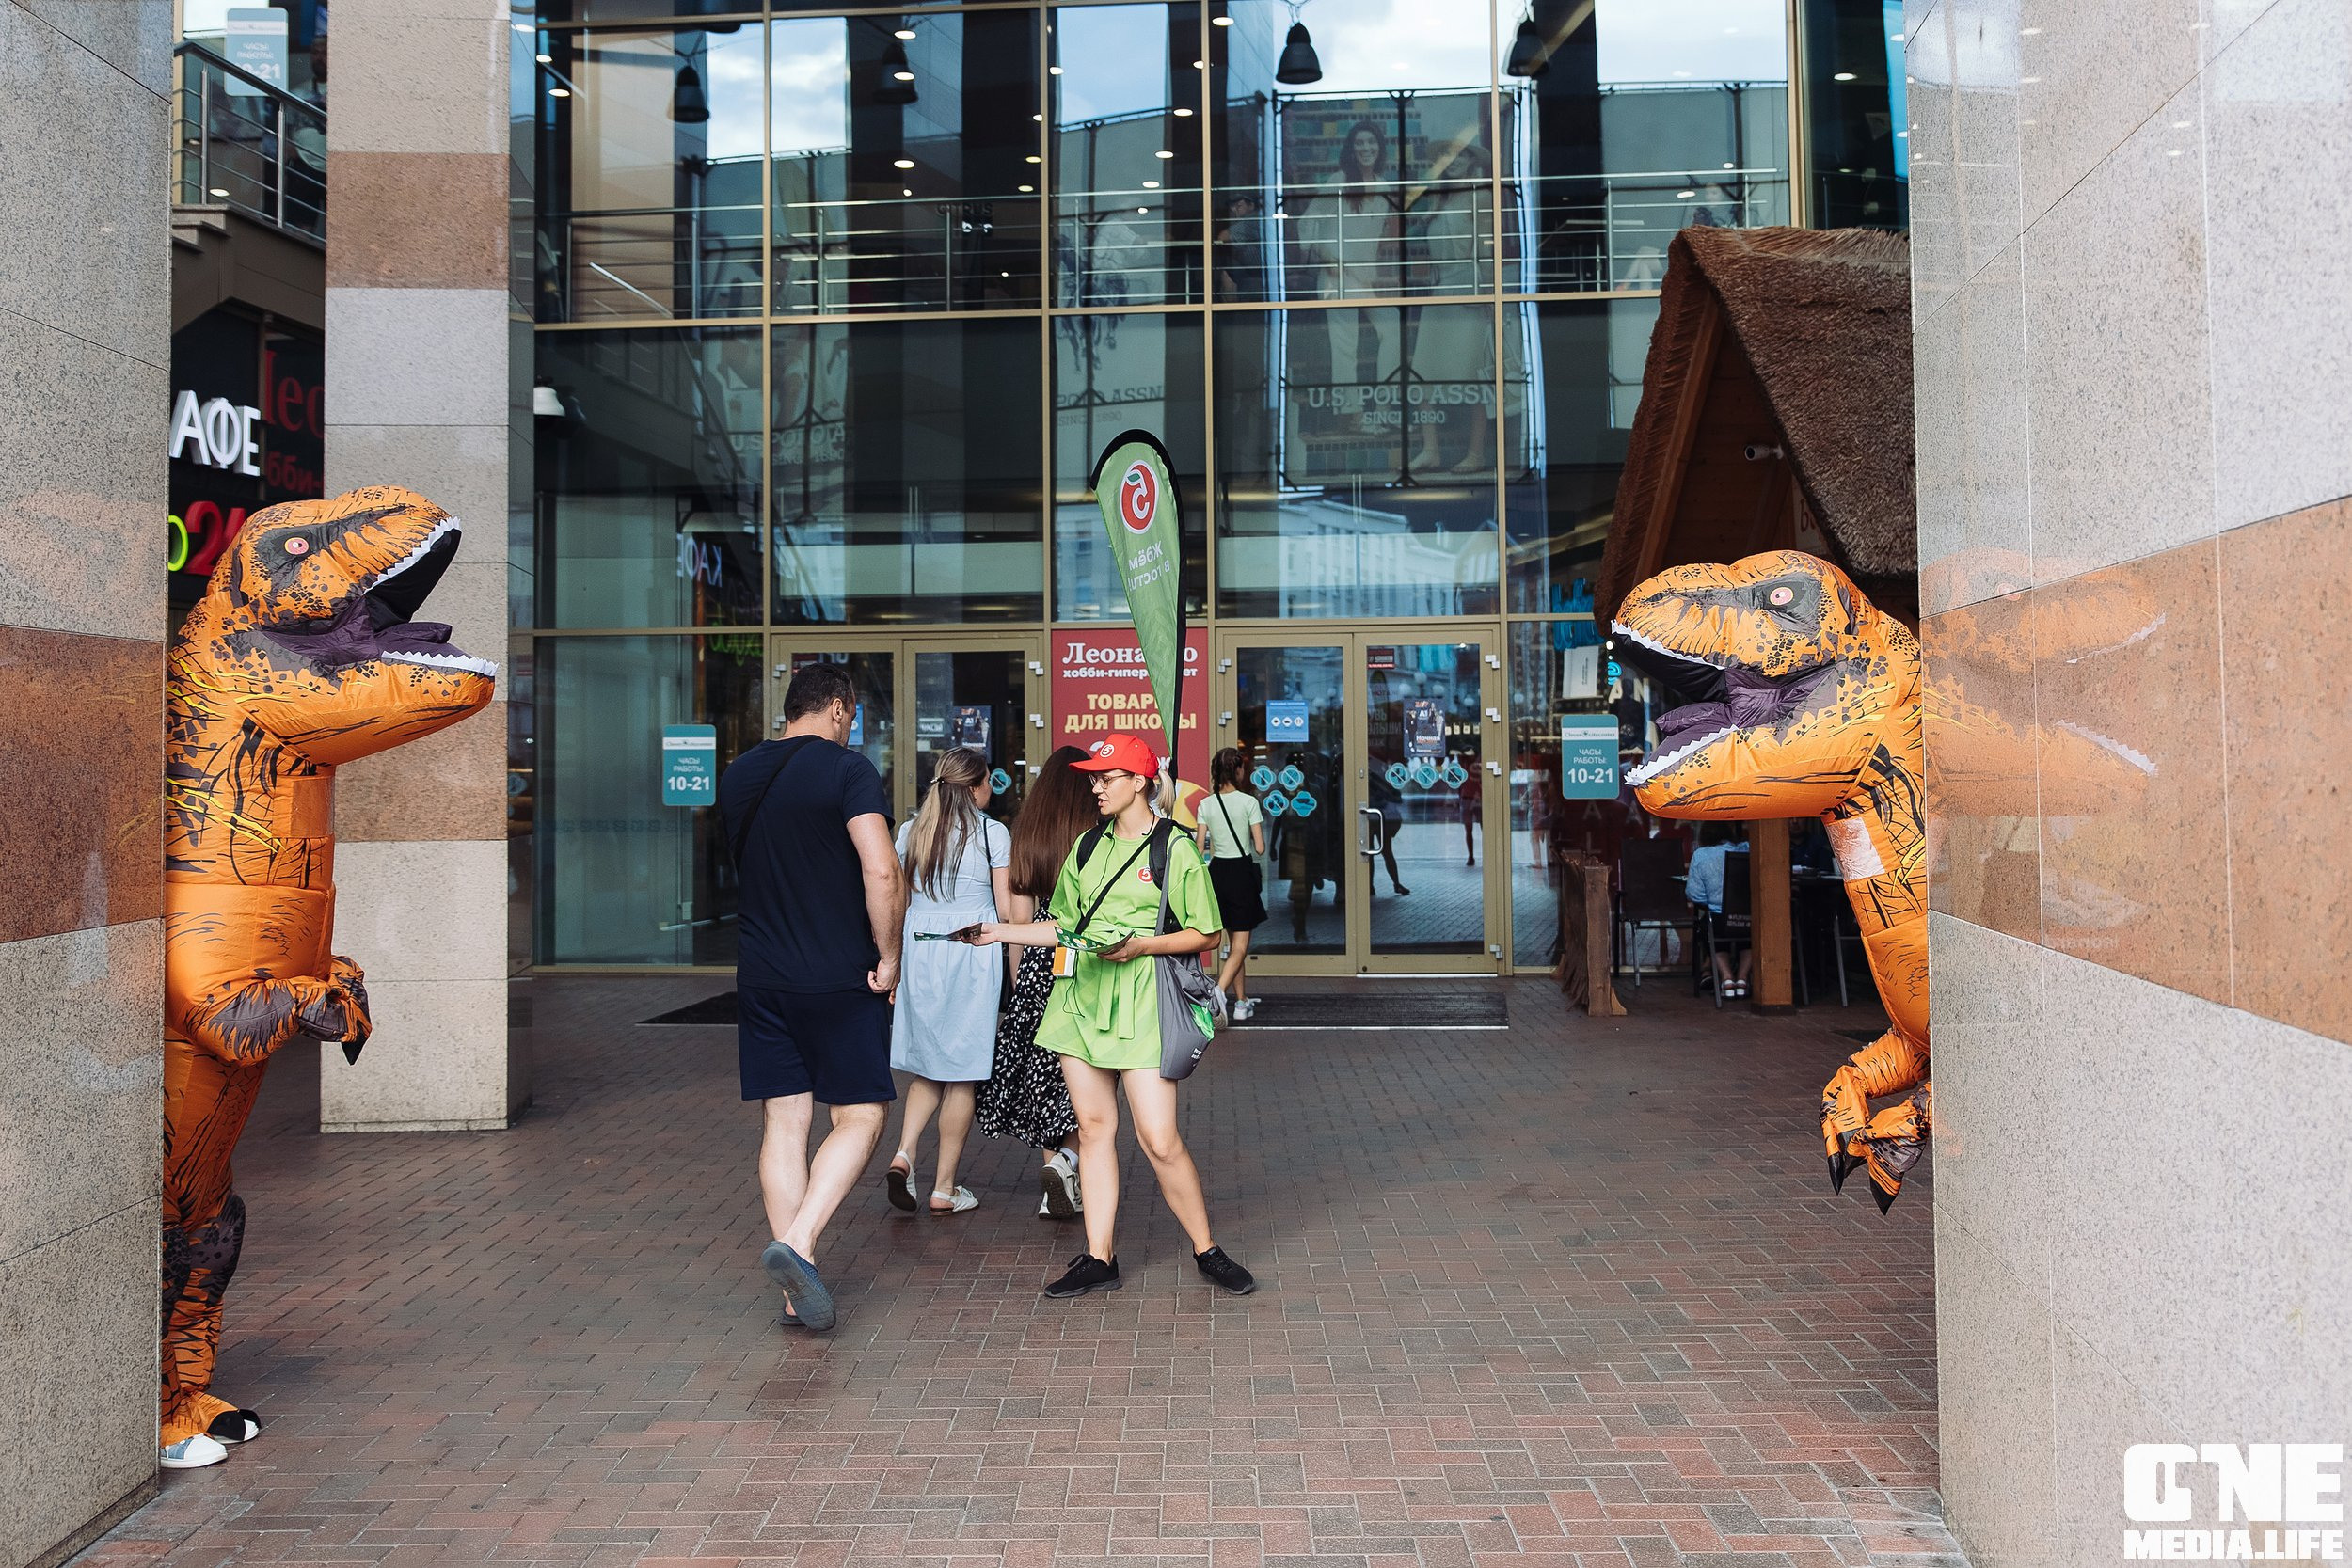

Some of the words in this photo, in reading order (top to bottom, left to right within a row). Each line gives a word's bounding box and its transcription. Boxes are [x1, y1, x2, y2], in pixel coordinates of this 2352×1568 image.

[235, 62, 281, 80] 0-21
[169, 389, 261, 477] АФЕ
[1062, 642, 1199, 664] Леонао
[1063, 667, 1198, 679] хобби-гиперет
[1064, 714, 1108, 733] ДЛЯ
[1114, 713, 1196, 730] ШКОЫ
[1579, 748, 1602, 756] ЧАСЫ
[667, 776, 710, 791] 10-21
[1567, 768, 1613, 784] 10-21
